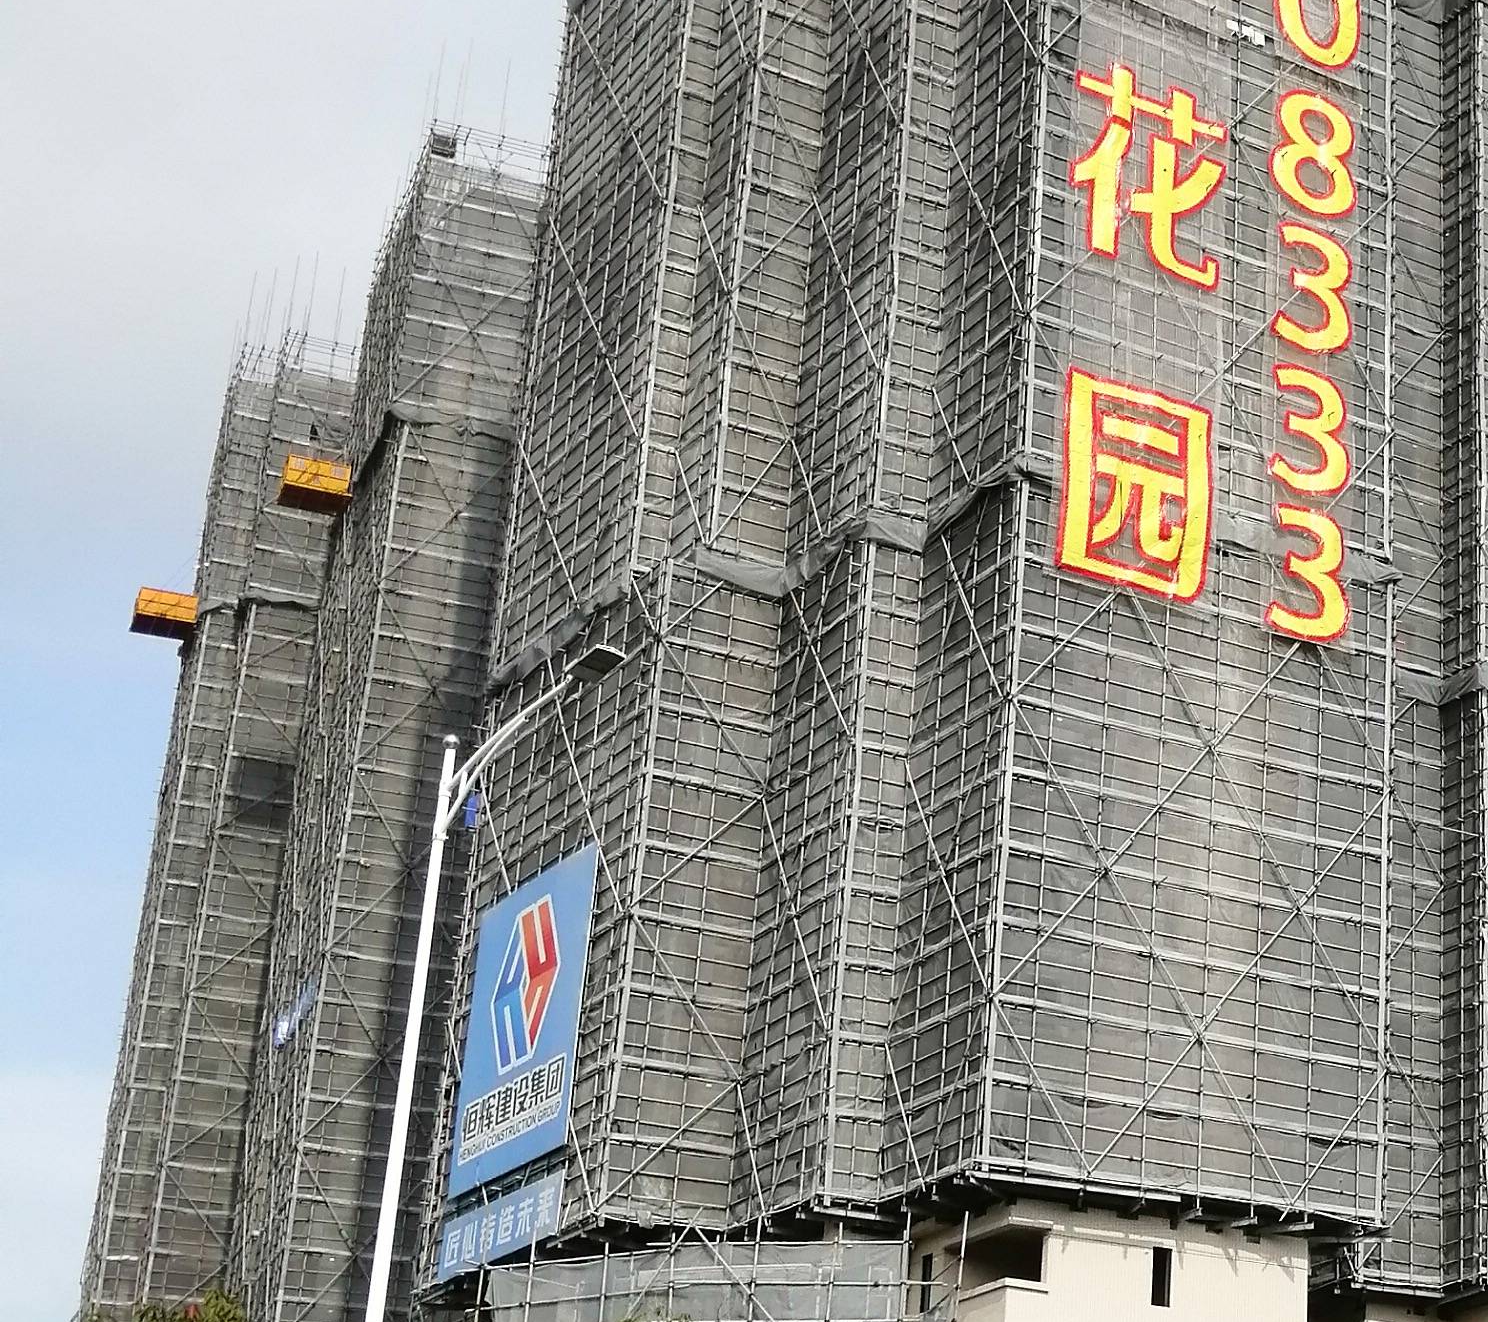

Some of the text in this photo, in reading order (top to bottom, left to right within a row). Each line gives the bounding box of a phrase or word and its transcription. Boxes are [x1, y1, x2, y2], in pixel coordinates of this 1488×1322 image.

[462, 1055, 565, 1143] 恒辉建设集团
[486, 1114, 538, 1149] CONSTRUCTION
[538, 1099, 562, 1124] GROUP
[443, 1186, 556, 1269] 匠心铸造未来
